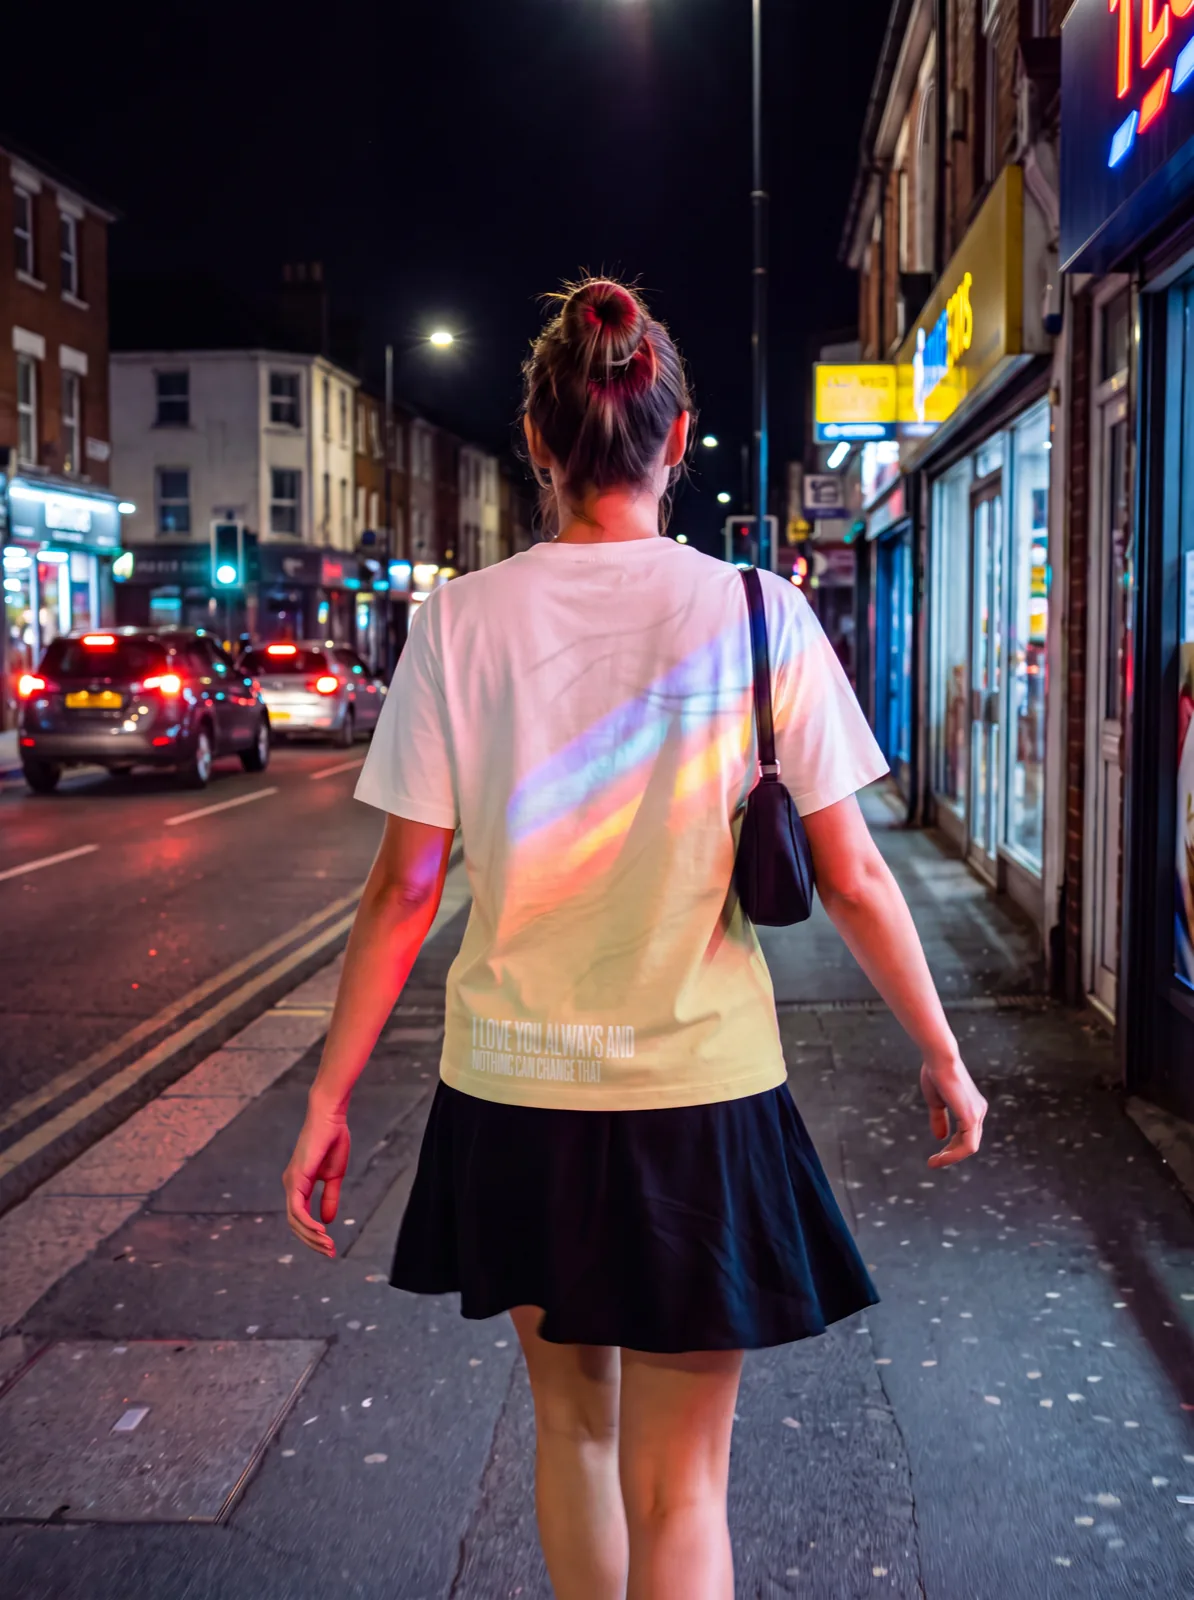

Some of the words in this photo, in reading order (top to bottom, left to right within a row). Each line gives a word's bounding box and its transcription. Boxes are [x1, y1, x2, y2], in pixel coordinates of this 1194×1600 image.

[479, 1018, 512, 1052] LOVE
[514, 1021, 542, 1054] YOU
[544, 1022, 604, 1058] ALWAYS
[606, 1025, 635, 1059] AND
[472, 1049, 514, 1076] NOTHING
[515, 1055, 535, 1079] CAN
[536, 1058, 575, 1082] CHANGE
[577, 1060, 602, 1083] THAT
